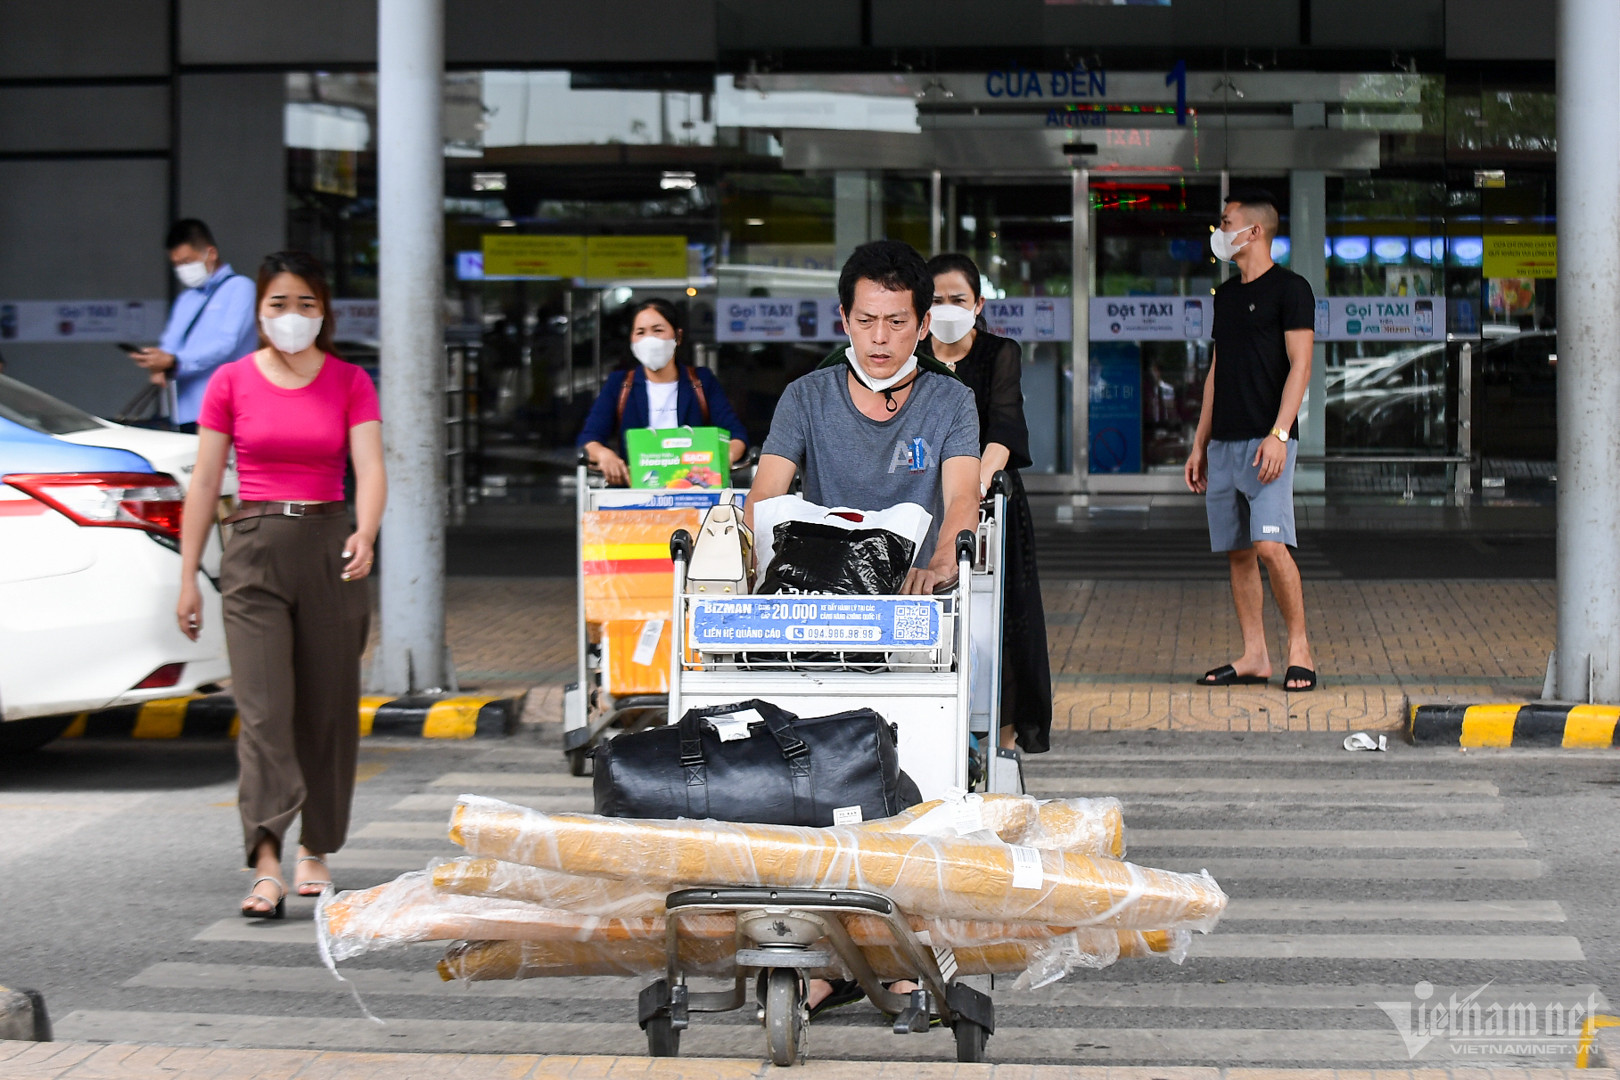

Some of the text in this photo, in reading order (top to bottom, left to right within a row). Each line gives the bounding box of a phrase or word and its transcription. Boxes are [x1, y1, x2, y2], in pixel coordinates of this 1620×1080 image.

[1165, 59, 1187, 126] 1
[1046, 108, 1106, 126] Arrival
[760, 304, 793, 317] TAXI
[990, 304, 1024, 317] TAXI
[1139, 303, 1173, 317] TAXI
[1345, 303, 1410, 320] Gọi TAXI
[771, 603, 818, 620] 20.000
[764, 627, 781, 638] CÁO
